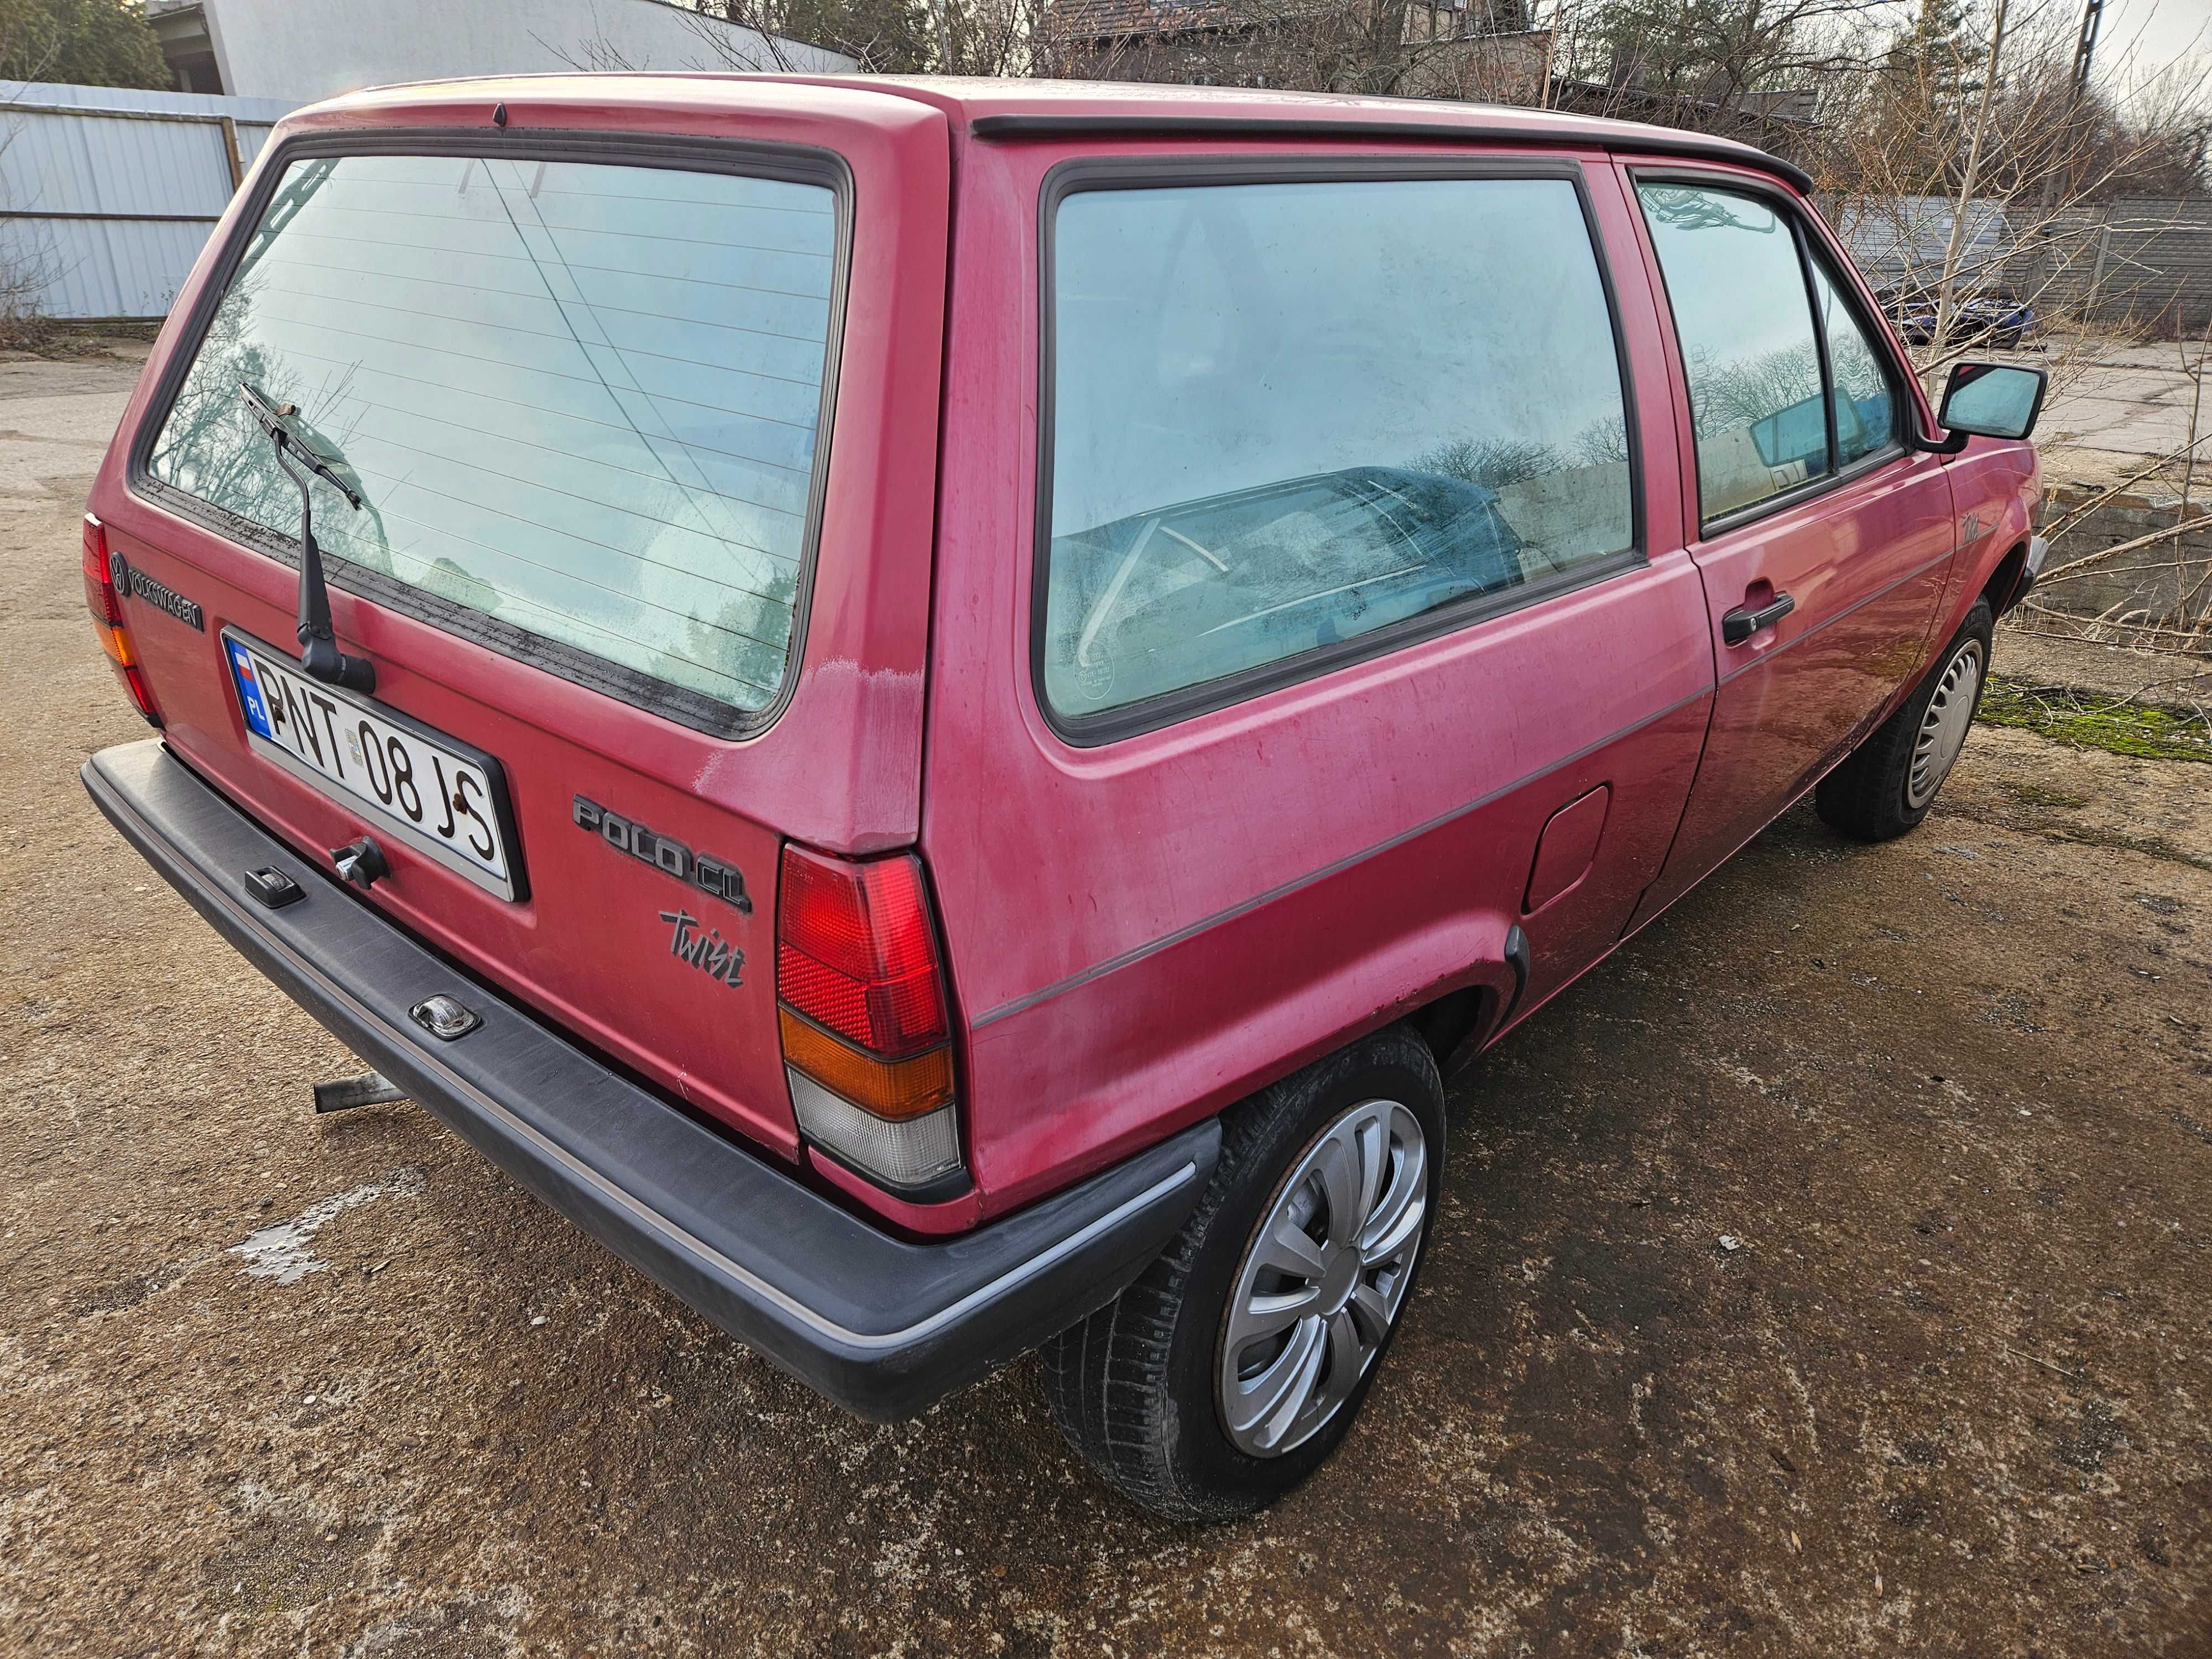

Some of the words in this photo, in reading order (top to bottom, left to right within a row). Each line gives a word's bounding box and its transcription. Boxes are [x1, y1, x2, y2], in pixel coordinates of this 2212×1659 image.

[128, 568, 198, 626] VOLKSWAGEN
[247, 696, 265, 721] PL
[254, 659, 345, 779] PNT
[572, 795, 687, 877] POLO
[696, 857, 742, 905] CL
[659, 909, 746, 989] Twist
